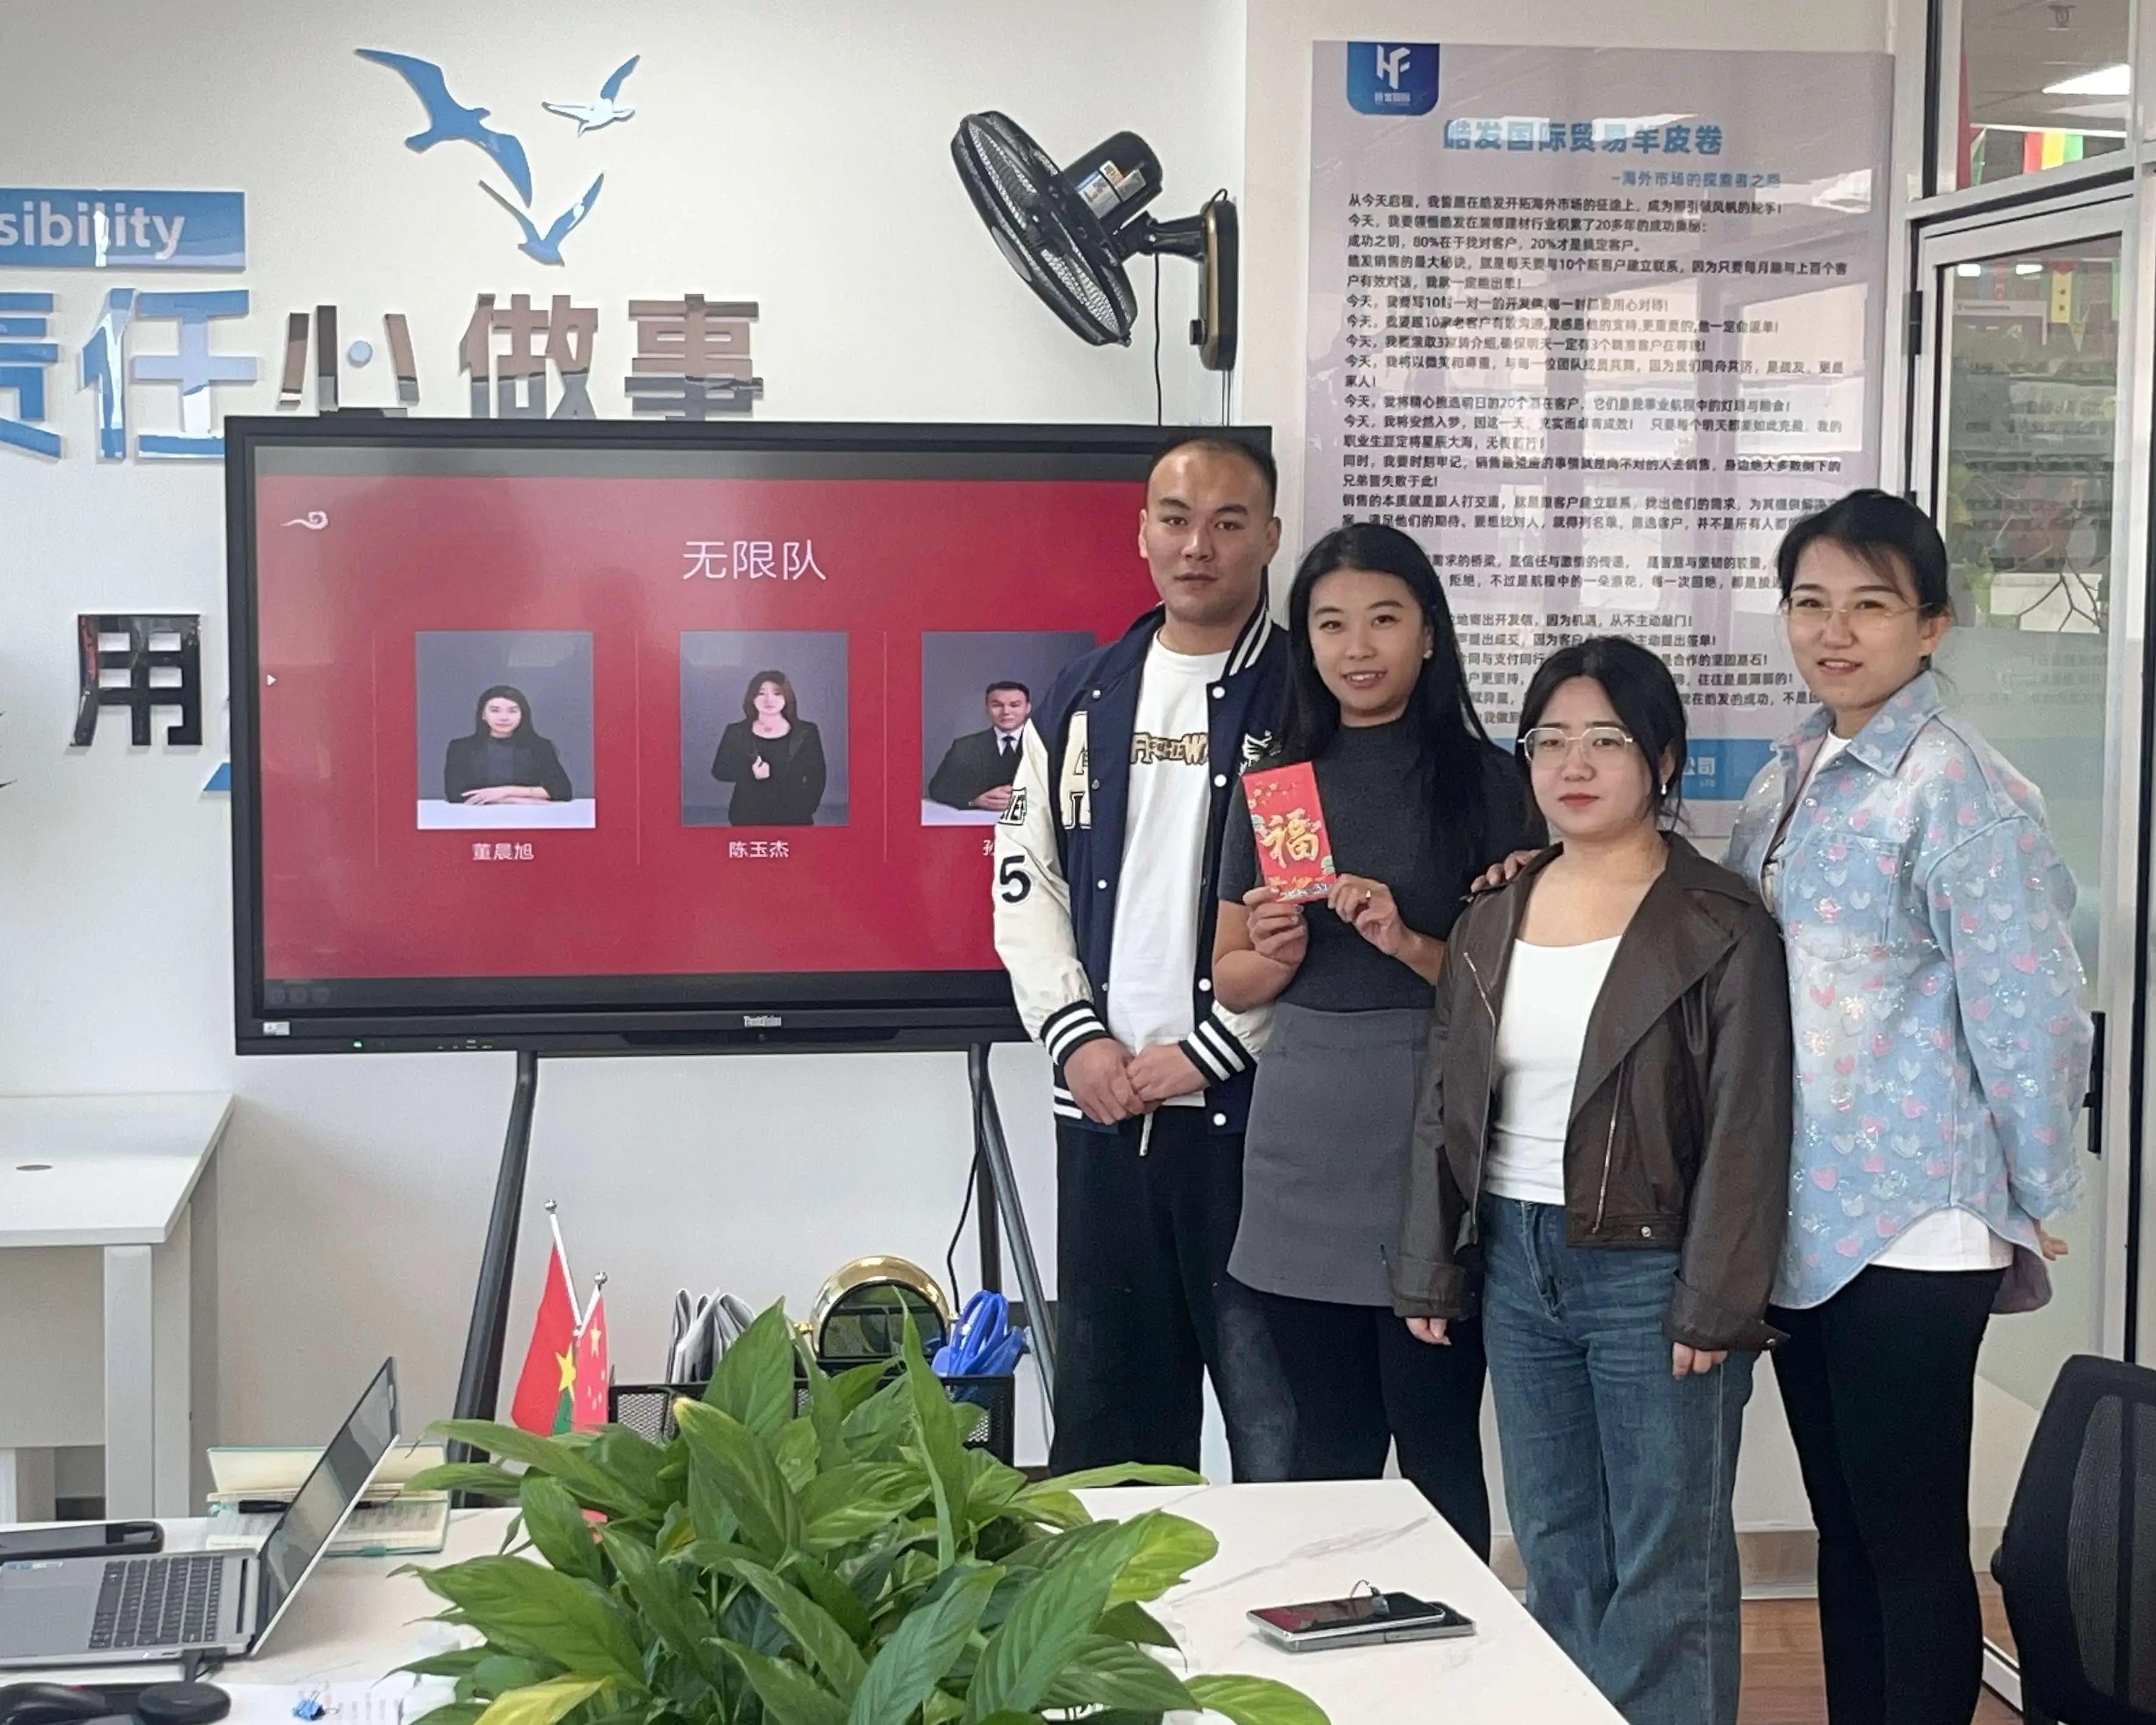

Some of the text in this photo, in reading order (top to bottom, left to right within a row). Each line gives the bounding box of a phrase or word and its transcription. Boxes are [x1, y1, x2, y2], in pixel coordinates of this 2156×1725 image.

[683, 539, 826, 580] 无限队
[70, 614, 203, 746] 用
[729, 841, 789, 859] 陈玉杰
[1260, 808, 1325, 869] 福
[1000, 855, 1031, 903] 5
